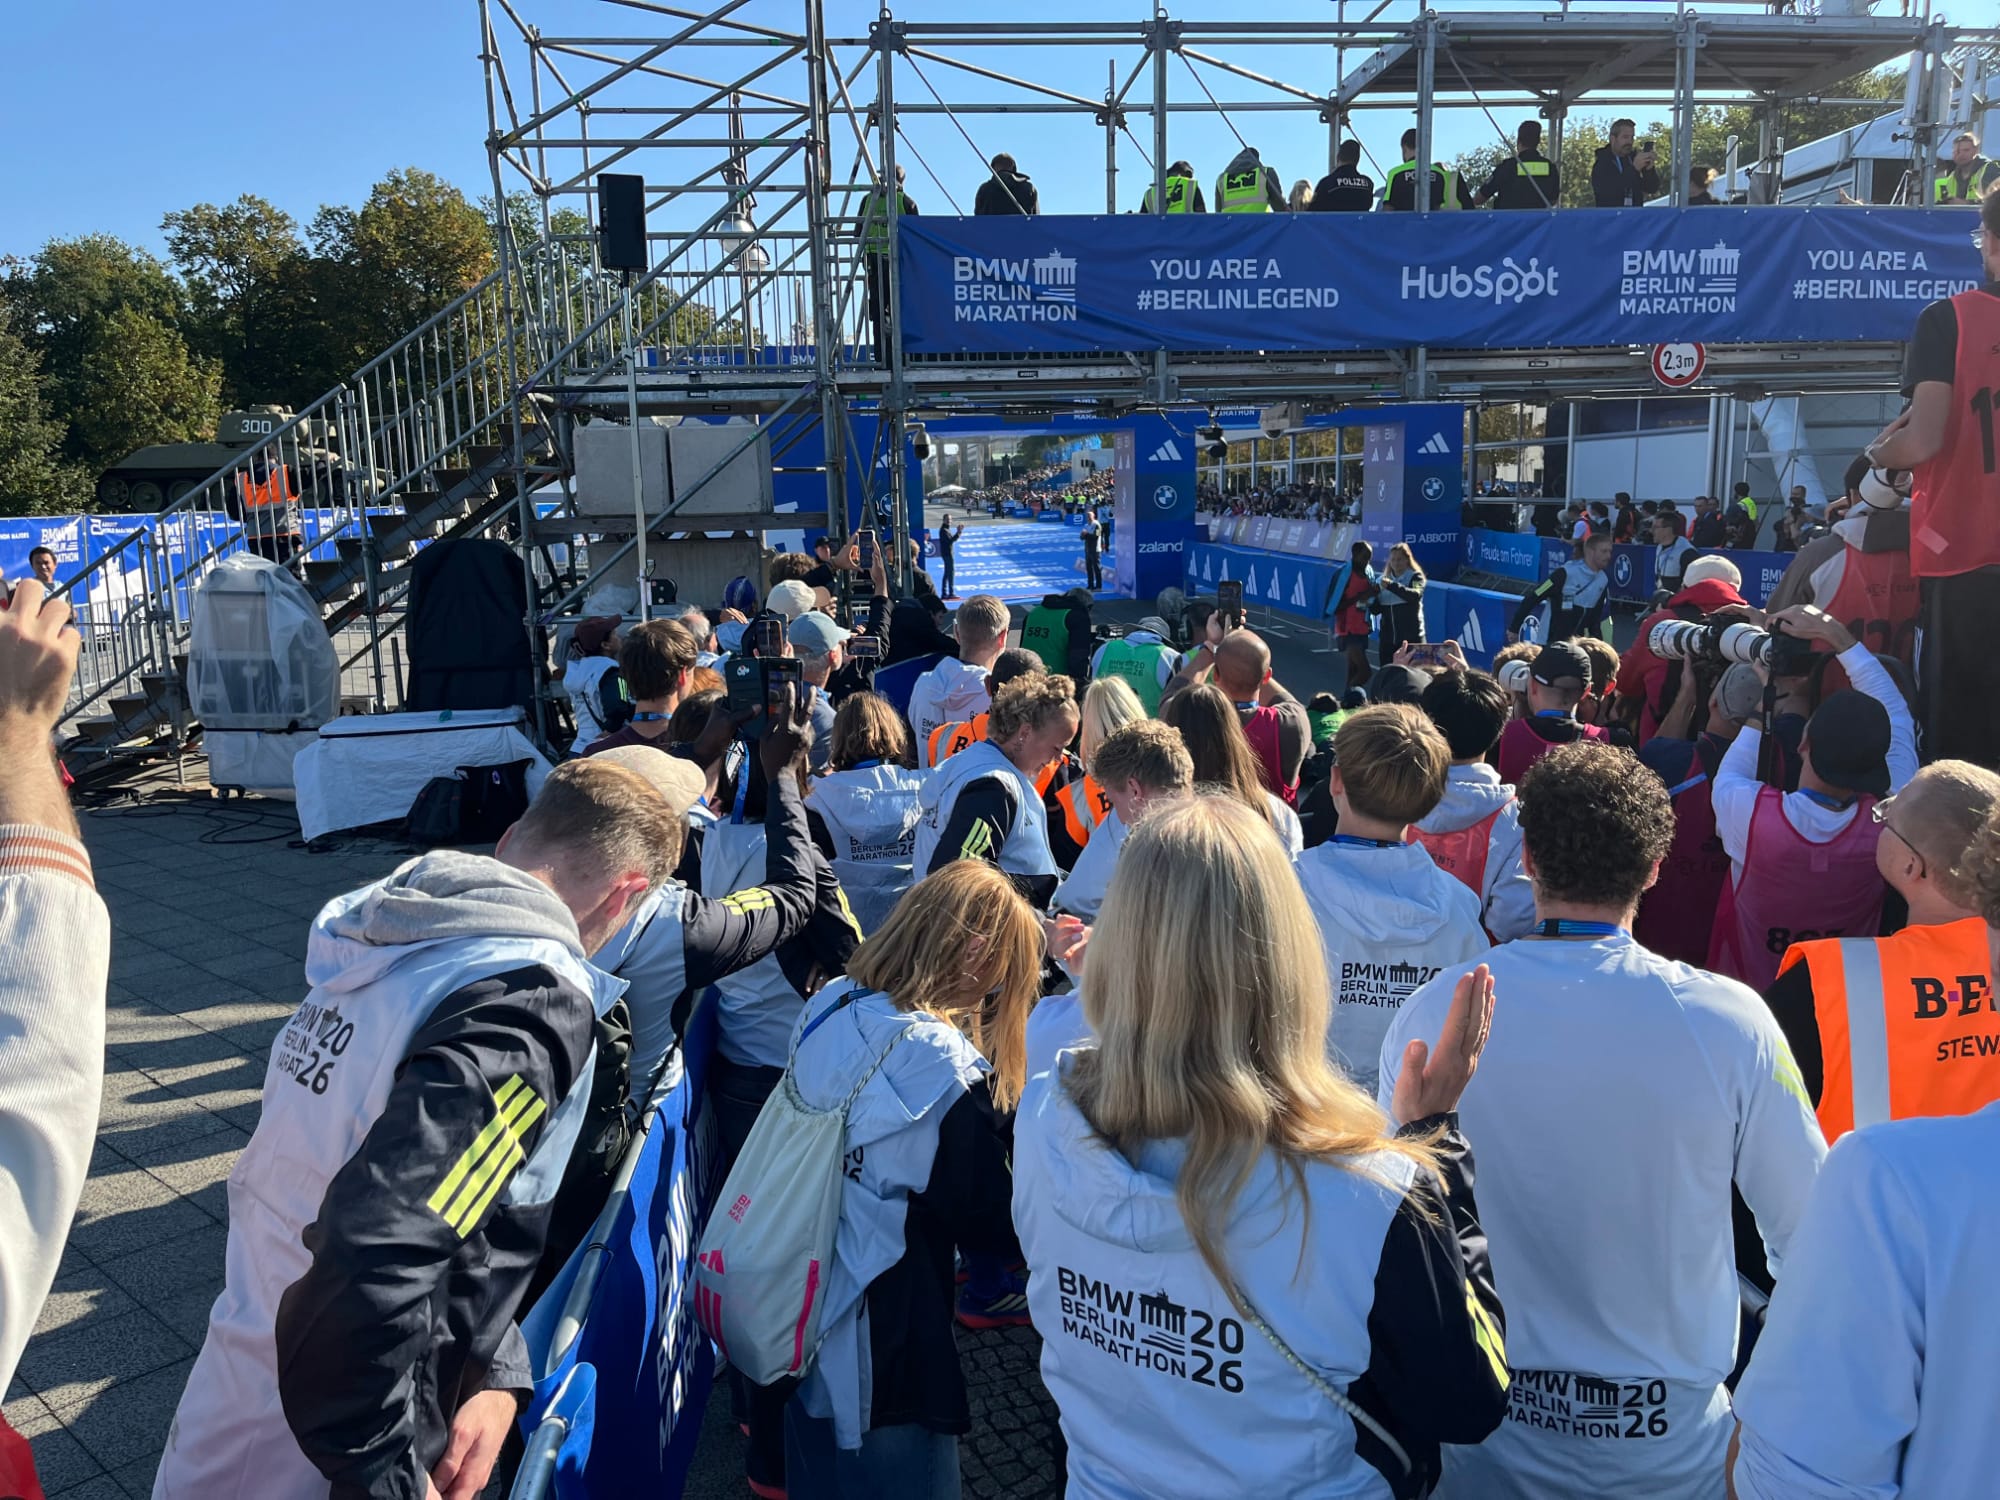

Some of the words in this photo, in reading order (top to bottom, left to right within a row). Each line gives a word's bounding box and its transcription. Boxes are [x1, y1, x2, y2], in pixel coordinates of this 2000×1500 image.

[1337, 177, 1369, 187] POLIZEI
[1404, 171, 1437, 181] POEI
[954, 256, 1030, 282] BMW
[1150, 260, 1201, 281] YOU
[1207, 259, 1257, 280] ARE
[1263, 259, 1281, 280] A
[1622, 249, 1696, 275] BMW
[1807, 250, 1855, 271] YOU
[1860, 251, 1906, 271] ARE
[1911, 251, 1928, 271] A
[954, 283, 1032, 301] BERLIN
[1401, 257, 1559, 305] HubSpot
[1620, 277, 1695, 295] BERLIN
[1136, 287, 1339, 311] #BERLINLEGEND
[1619, 296, 1736, 316] MARATHON
[954, 304, 1077, 322] MARATHON
[241, 419, 272, 434] 300
[1970, 386, 2000, 474] 1
[1138, 538, 1184, 553] zaland
[1418, 532, 1459, 544] ABBOTT
[1027, 626, 1050, 639] 583
[851, 844, 882, 854] BERLIN
[851, 850, 899, 861] MARATHON
[1342, 962, 1388, 981] BMW
[1340, 980, 1388, 994] BERLIN
[1339, 993, 1406, 1008] MARATHO
[318, 1016, 354, 1056] 20
[1936, 1035, 2000, 1061] STEW
[295, 1050, 336, 1096] 26
[1057, 1266, 1134, 1318] BMW
[1060, 1295, 1135, 1341] BERLIN
[1190, 1310, 1244, 1354] 20
[1063, 1317, 1186, 1379] MARATHON
[1191, 1349, 1244, 1394] 26
[1507, 1387, 1571, 1416] ERLIN
[1623, 1379, 1667, 1408] 20
[1623, 1408, 1668, 1438] 26
